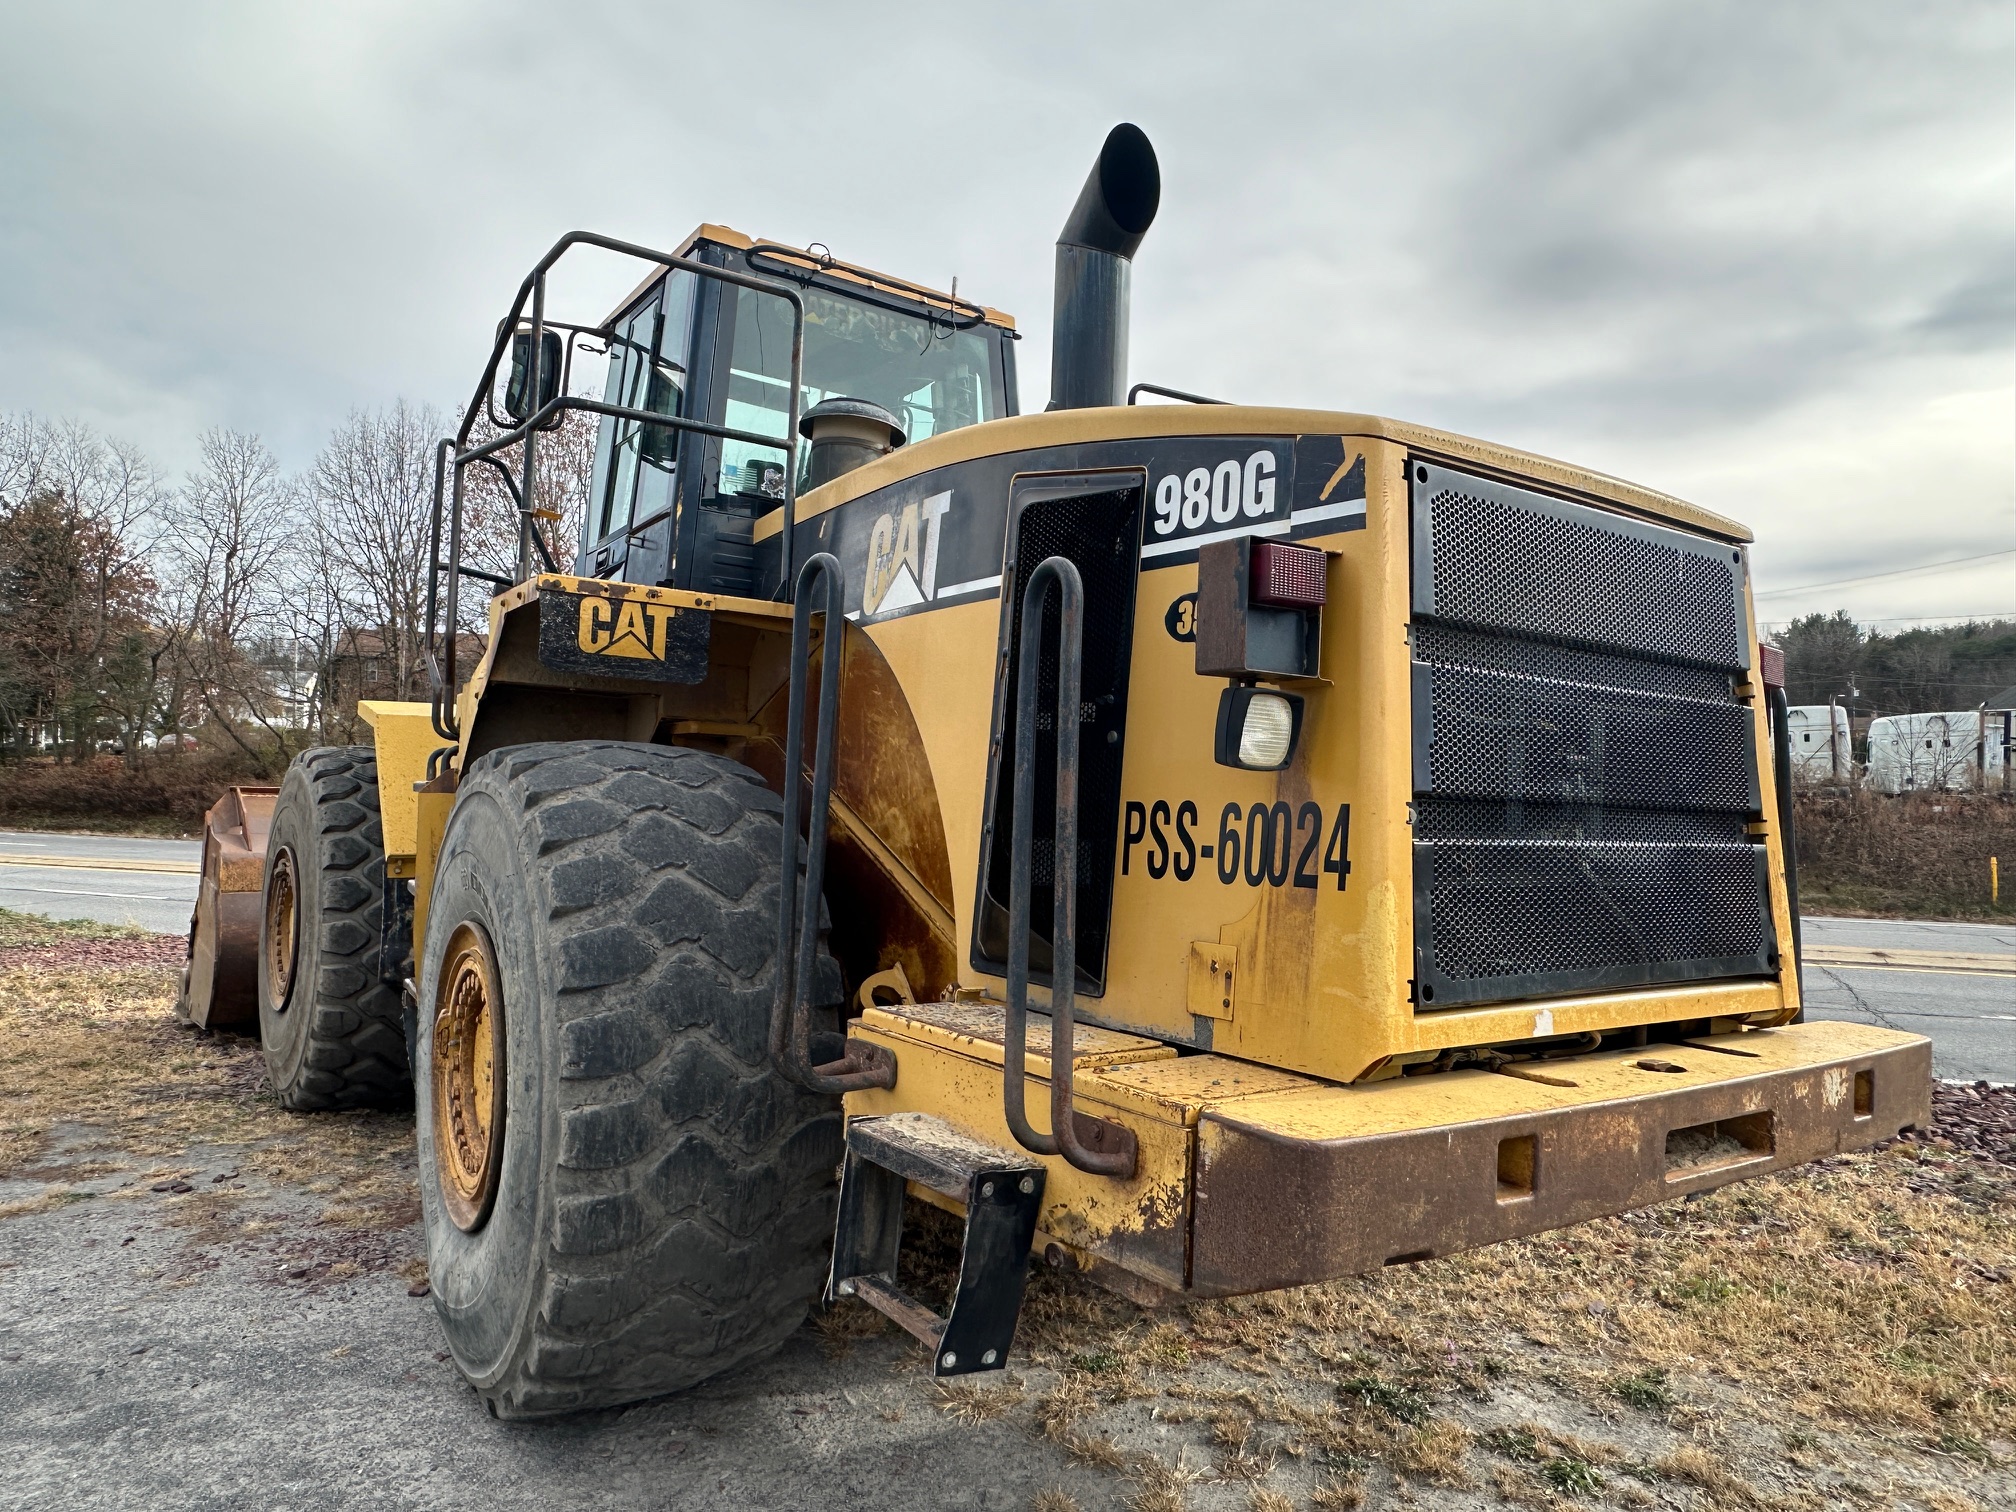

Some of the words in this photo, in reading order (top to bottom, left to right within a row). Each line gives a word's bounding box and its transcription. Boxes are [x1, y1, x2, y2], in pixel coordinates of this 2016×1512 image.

[1154, 450, 1276, 535] 980G
[863, 489, 951, 616] CAT
[578, 596, 676, 662] CAT
[1176, 600, 1198, 635] 3
[1122, 800, 1351, 891] PSS-60024
